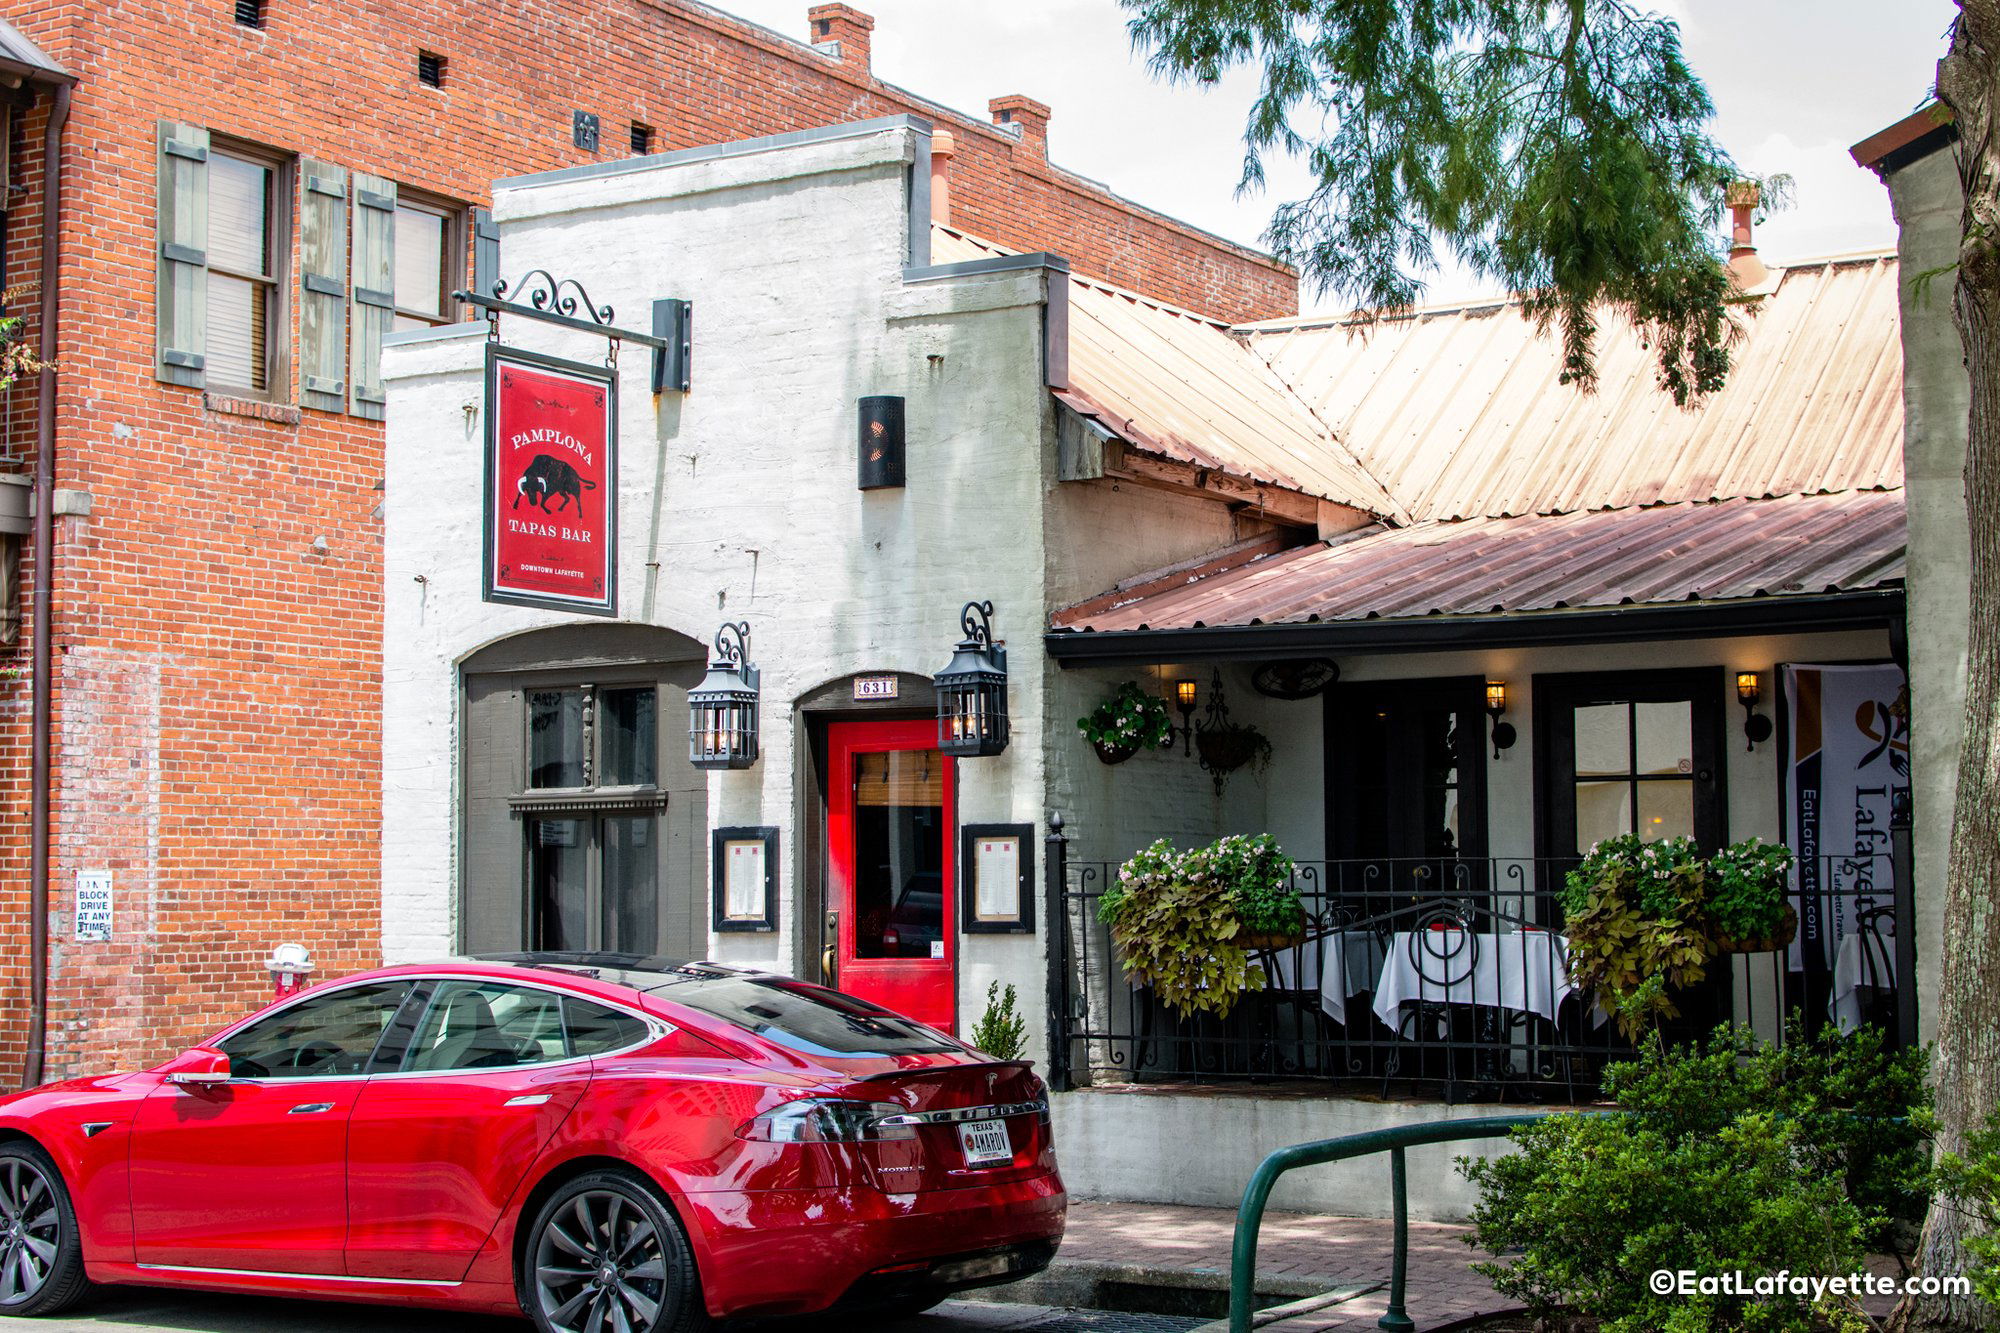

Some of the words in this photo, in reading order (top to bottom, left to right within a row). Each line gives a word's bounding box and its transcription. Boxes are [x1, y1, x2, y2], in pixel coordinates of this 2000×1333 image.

[511, 428, 592, 466] PAMPLONA
[508, 519, 557, 537] TAPAS
[561, 527, 591, 542] BAR
[520, 563, 554, 575] DOWNTOWN
[555, 566, 585, 578] LAFAYETTE
[863, 682, 887, 693] 631
[80, 891, 109, 900] BLOCK
[81, 901, 108, 910] DRIVE
[78, 912, 89, 920] AT
[92, 912, 111, 920] ANY
[84, 922, 105, 931] TIME
[972, 1122, 993, 1132] TEXAS
